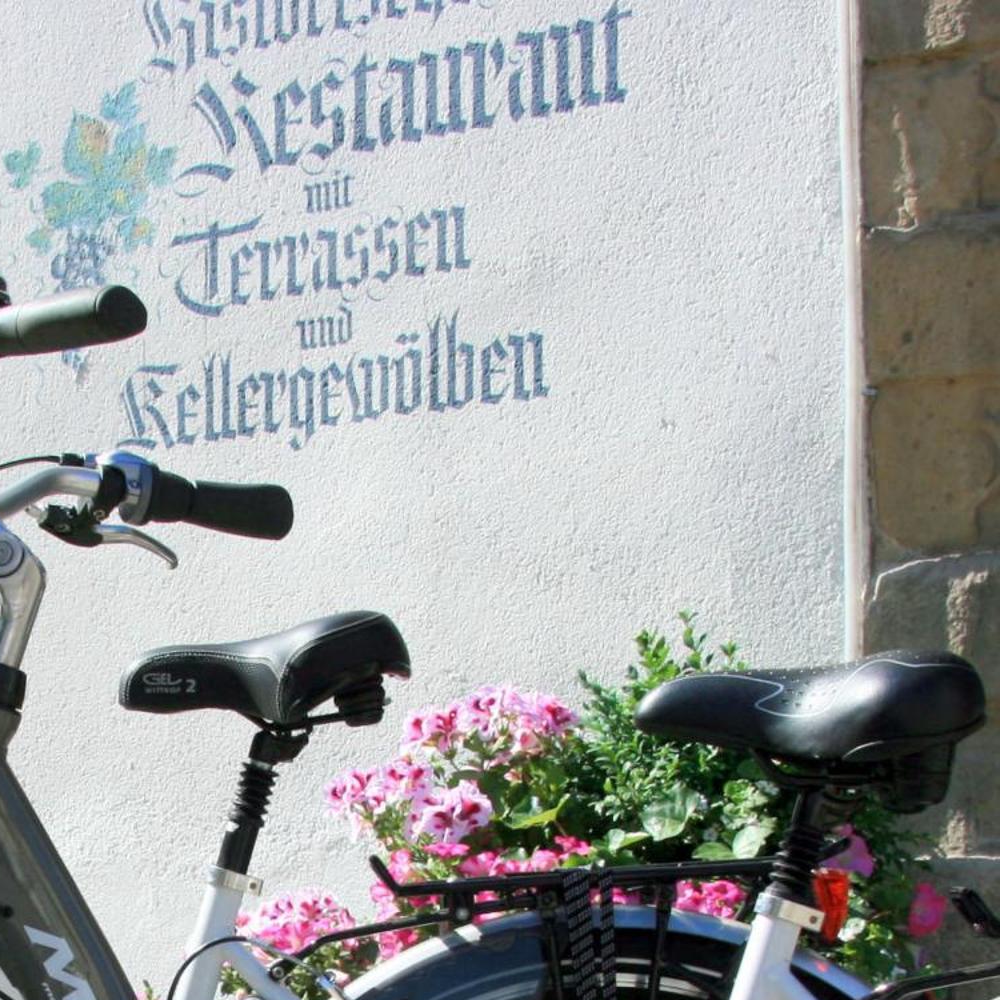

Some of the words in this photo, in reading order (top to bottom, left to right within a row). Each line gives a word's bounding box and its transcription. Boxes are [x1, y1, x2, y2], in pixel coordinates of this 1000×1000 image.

[174, 2, 633, 197] Restaurant
[303, 170, 355, 213] mit
[171, 205, 471, 317] Terrassen
[295, 307, 353, 350] und
[116, 309, 549, 451] Kellergewölben
[142, 673, 182, 685] GEL
[185, 679, 197, 693] 2
